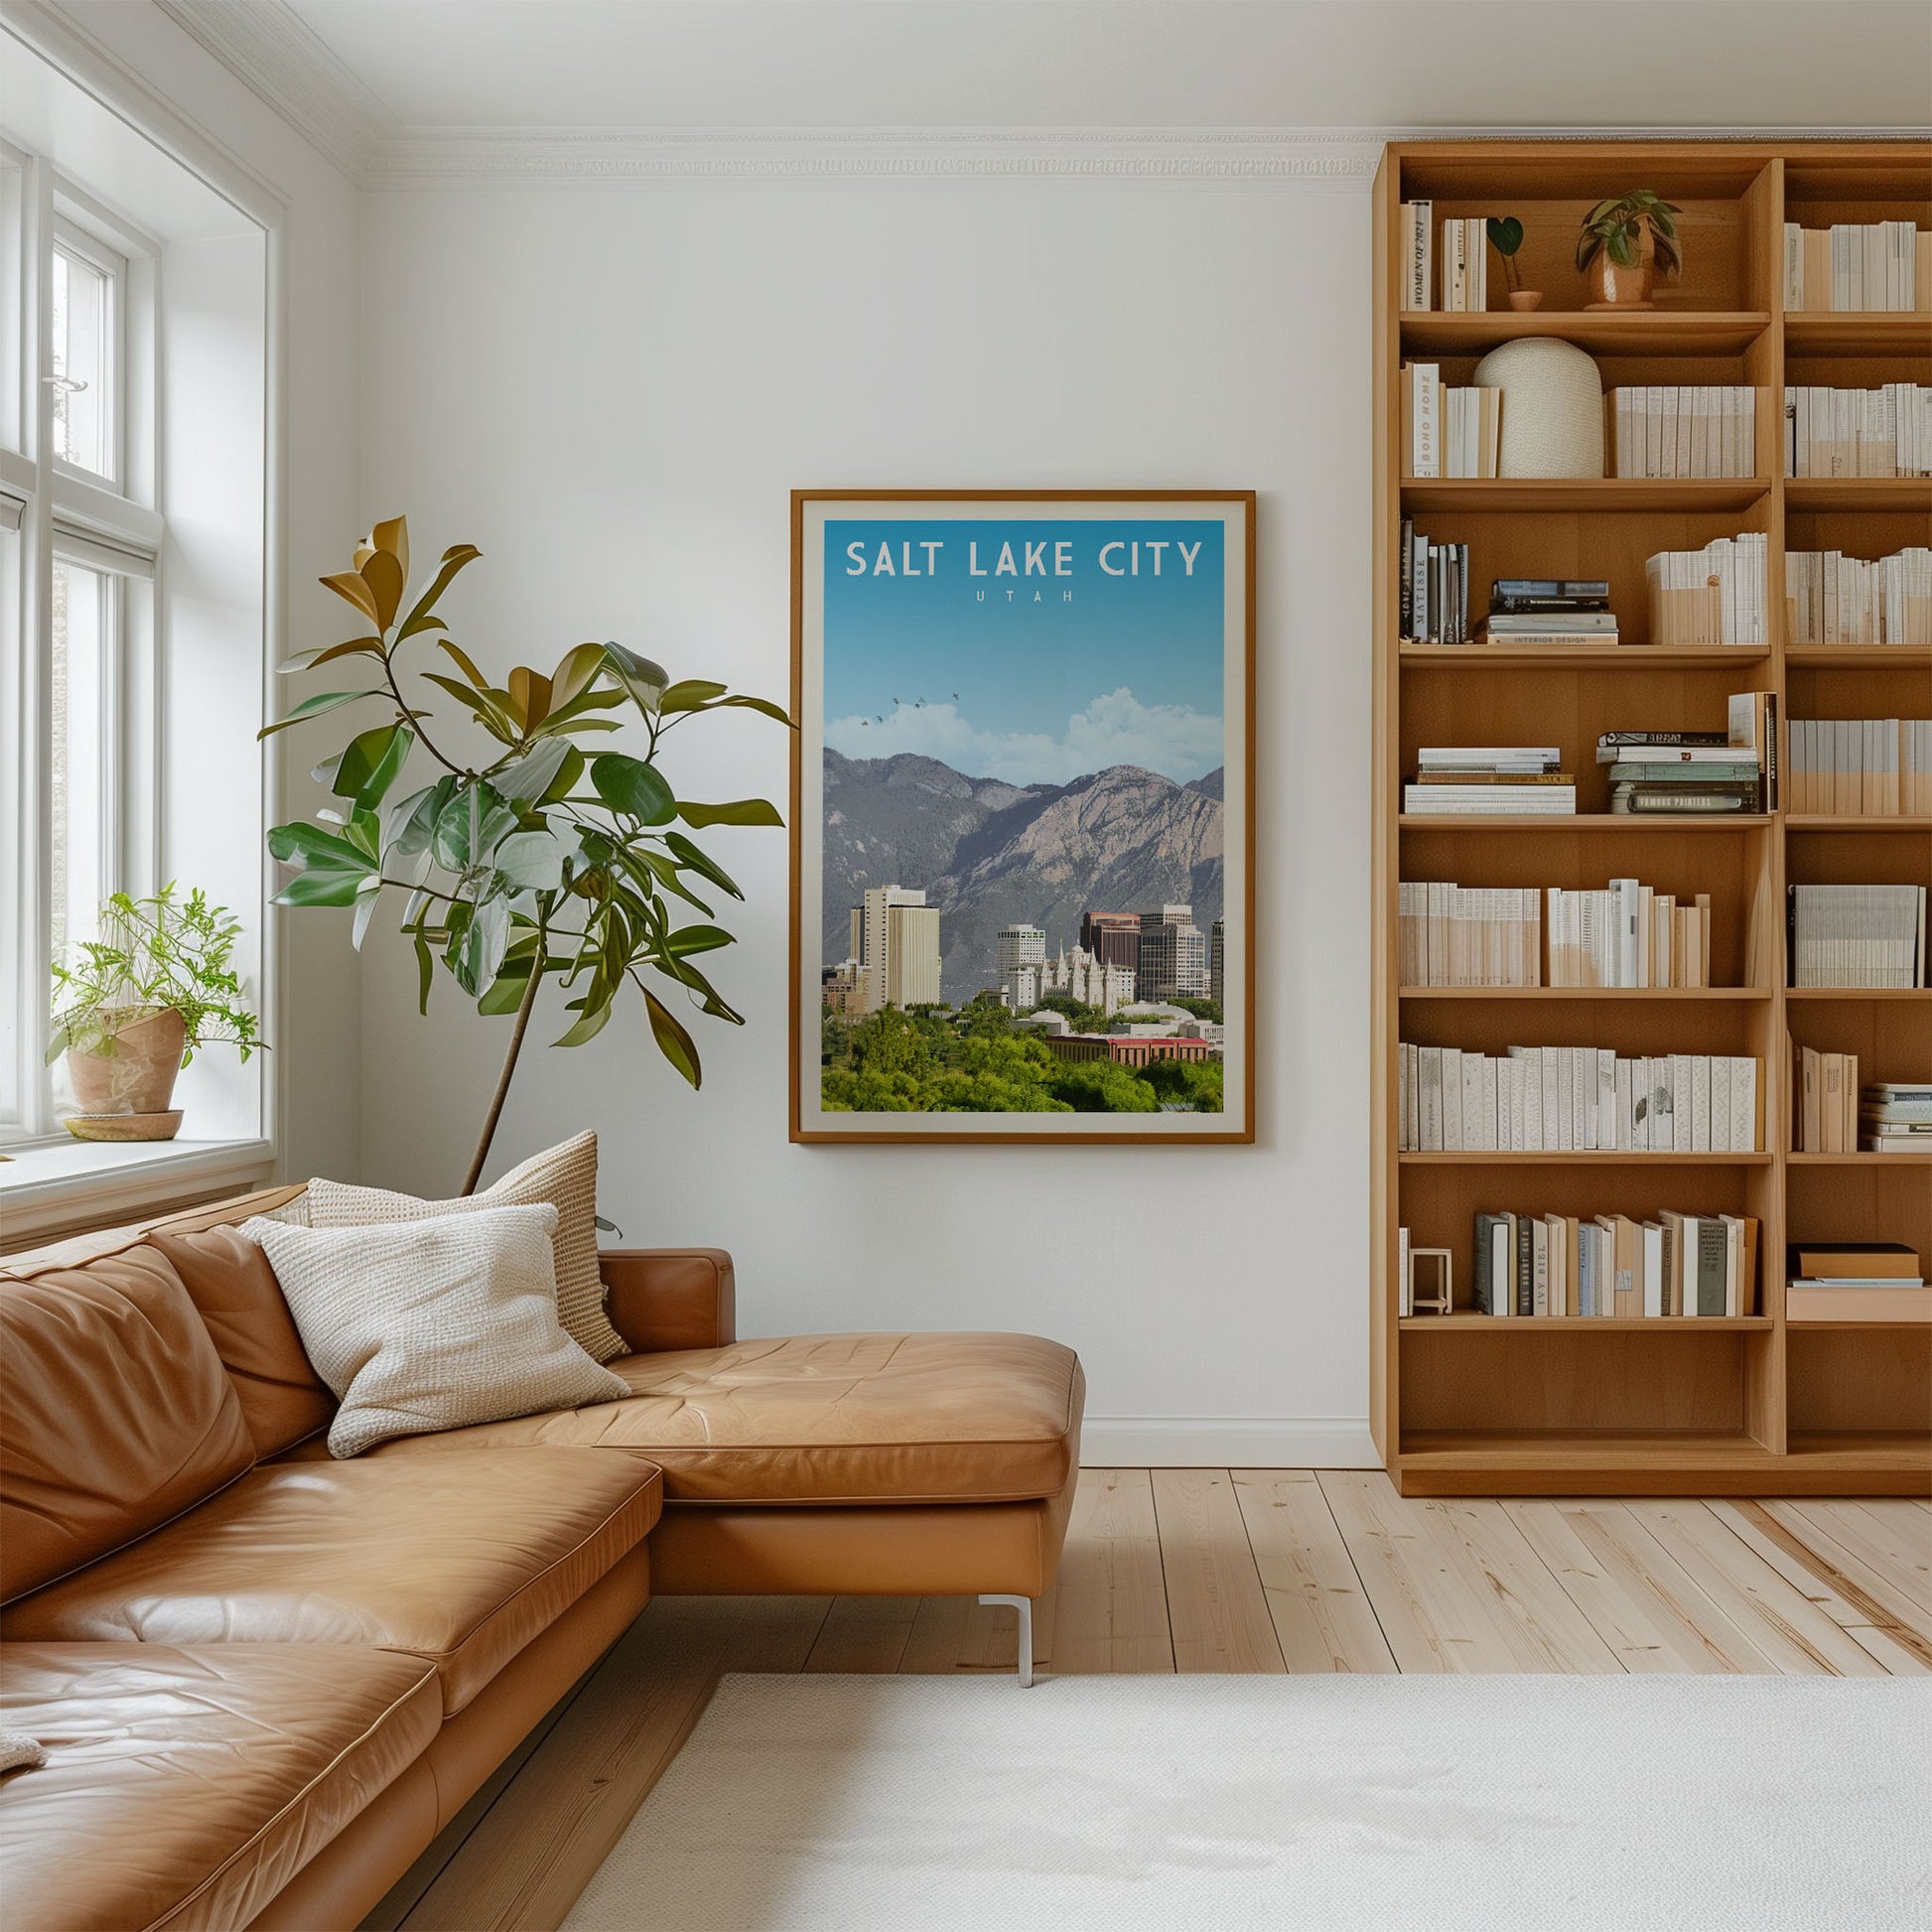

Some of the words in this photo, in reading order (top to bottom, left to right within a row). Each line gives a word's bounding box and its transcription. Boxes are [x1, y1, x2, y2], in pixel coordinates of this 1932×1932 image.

[1415, 247, 1424, 260] OF
[1415, 263, 1424, 305] WOMEN
[846, 541, 944, 576] SALT
[969, 541, 1073, 576] LAKE
[1098, 541, 1202, 576] CITY
[976, 590, 1073, 603] UTAH
[1416, 559, 1426, 624] MATISSE
[1639, 797, 1671, 806] FAMOUS
[1537, 1245, 1546, 1275] BIEL
[1537, 1283, 1546, 1306] IVY
